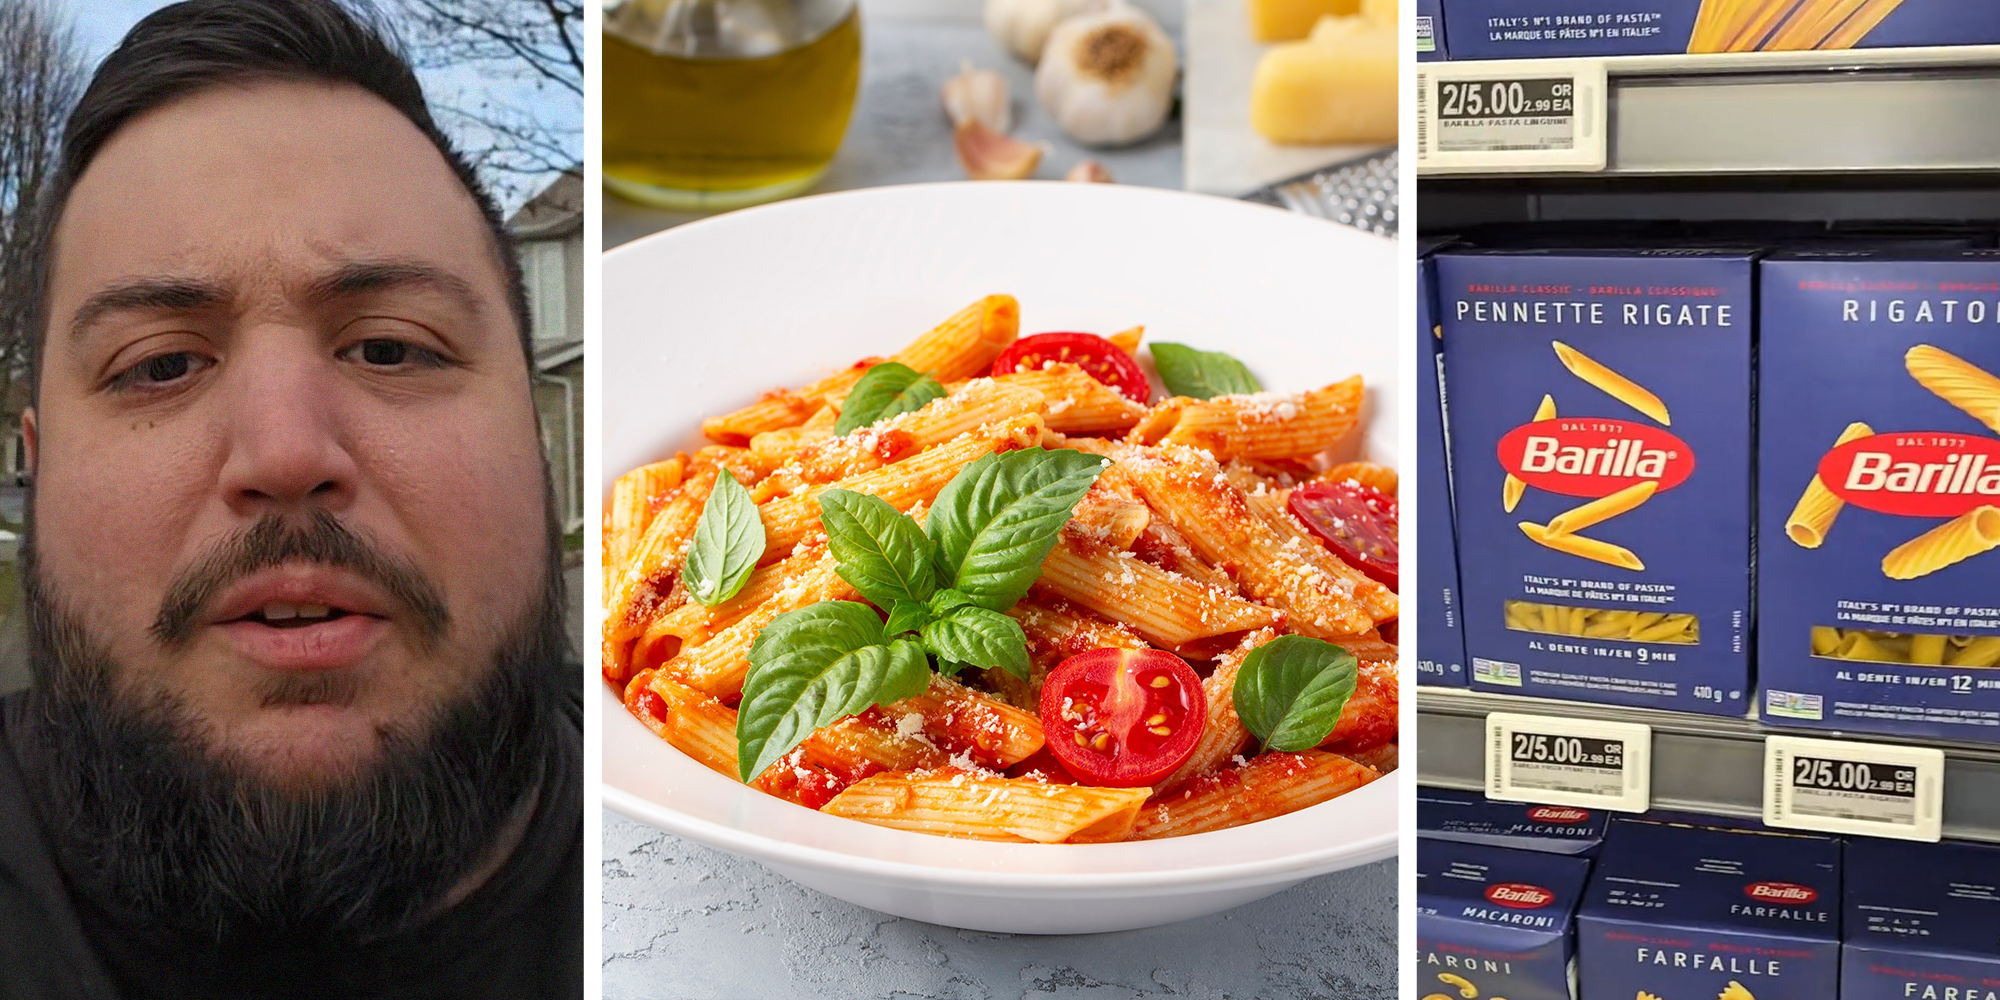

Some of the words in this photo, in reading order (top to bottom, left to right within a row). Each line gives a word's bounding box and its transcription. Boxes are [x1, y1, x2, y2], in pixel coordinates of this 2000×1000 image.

[1488, 17, 1528, 27] ITALY'S
[1556, 15, 1593, 26] BRAND
[1597, 14, 1612, 24] OF
[1490, 31, 1502, 41] LA
[1504, 30, 1542, 40] MARQUE
[1544, 29, 1557, 39] DE
[1559, 27, 1587, 39] PÂTES
[1606, 28, 1619, 37] EN
[1551, 84, 1572, 97] OR
[1442, 82, 1525, 116] 2/5.00
[1524, 100, 1550, 112] 2.99
[1552, 99, 1572, 111] EA
[1443, 119, 1484, 127] BARILLA
[1488, 118, 1521, 126] PASTA
[1524, 117, 1568, 126] LINGUINE
[1468, 284, 1517, 294] BARILLA
[1522, 284, 1571, 294] CLASSIC
[1589, 286, 1642, 296] BARILLA
[1456, 301, 1604, 325] PENNETTE
[1623, 303, 1733, 327] RIGATE
[1843, 299, 2000, 324] RIGATO
[1561, 423, 1587, 431] DAL
[1592, 423, 1623, 433] 1877
[1895, 438, 1925, 447] DAL
[1931, 438, 1966, 448] 1877
[1523, 575, 1559, 586] ITALY'S
[1581, 580, 1614, 590] BRAND
[1617, 582, 1632, 591] OF
[1525, 585, 1536, 594] LA
[1537, 587, 1570, 597] MARQUE
[1572, 589, 1583, 598] DE
[1627, 593, 1639, 602] EN
[1837, 600, 1879, 611] ITALY'S
[1903, 605, 1942, 615] BRAND
[1945, 607, 1960, 616] OF
[1837, 612, 1850, 620] LA
[1851, 614, 1891, 623] MARQUE
[1892, 616, 1906, 625] DE
[1528, 641, 1545, 650] AL
[1548, 643, 1589, 655] DENTE
[1636, 647, 1649, 662] 9
[1651, 652, 1677, 662] MIN
[1435, 663, 1444, 676] g
[1836, 671, 1853, 681] AL
[1857, 673, 1901, 684] DENTE
[1951, 675, 1973, 690] 12
[1713, 689, 1722, 703] g
[1514, 734, 1582, 764] 2/5.00
[1604, 744, 1622, 754] OR
[1581, 753, 1604, 764] 2.99
[1605, 755, 1622, 765] EA
[1795, 758, 1871, 790] 2/5.00
[1894, 770, 1914, 781] OR
[1869, 780, 1895, 791] 2.99
[1895, 782, 1914, 793] EA
[1534, 808, 1589, 820] Barilla
[1511, 824, 1593, 836] MACARONI
[1491, 887, 1551, 904] Barilla
[1751, 885, 1812, 900] Barilla
[1462, 907, 1554, 927] MACARONI
[1730, 904, 1829, 923] FARFALLE
[1637, 947, 1781, 976] FARFALLE
